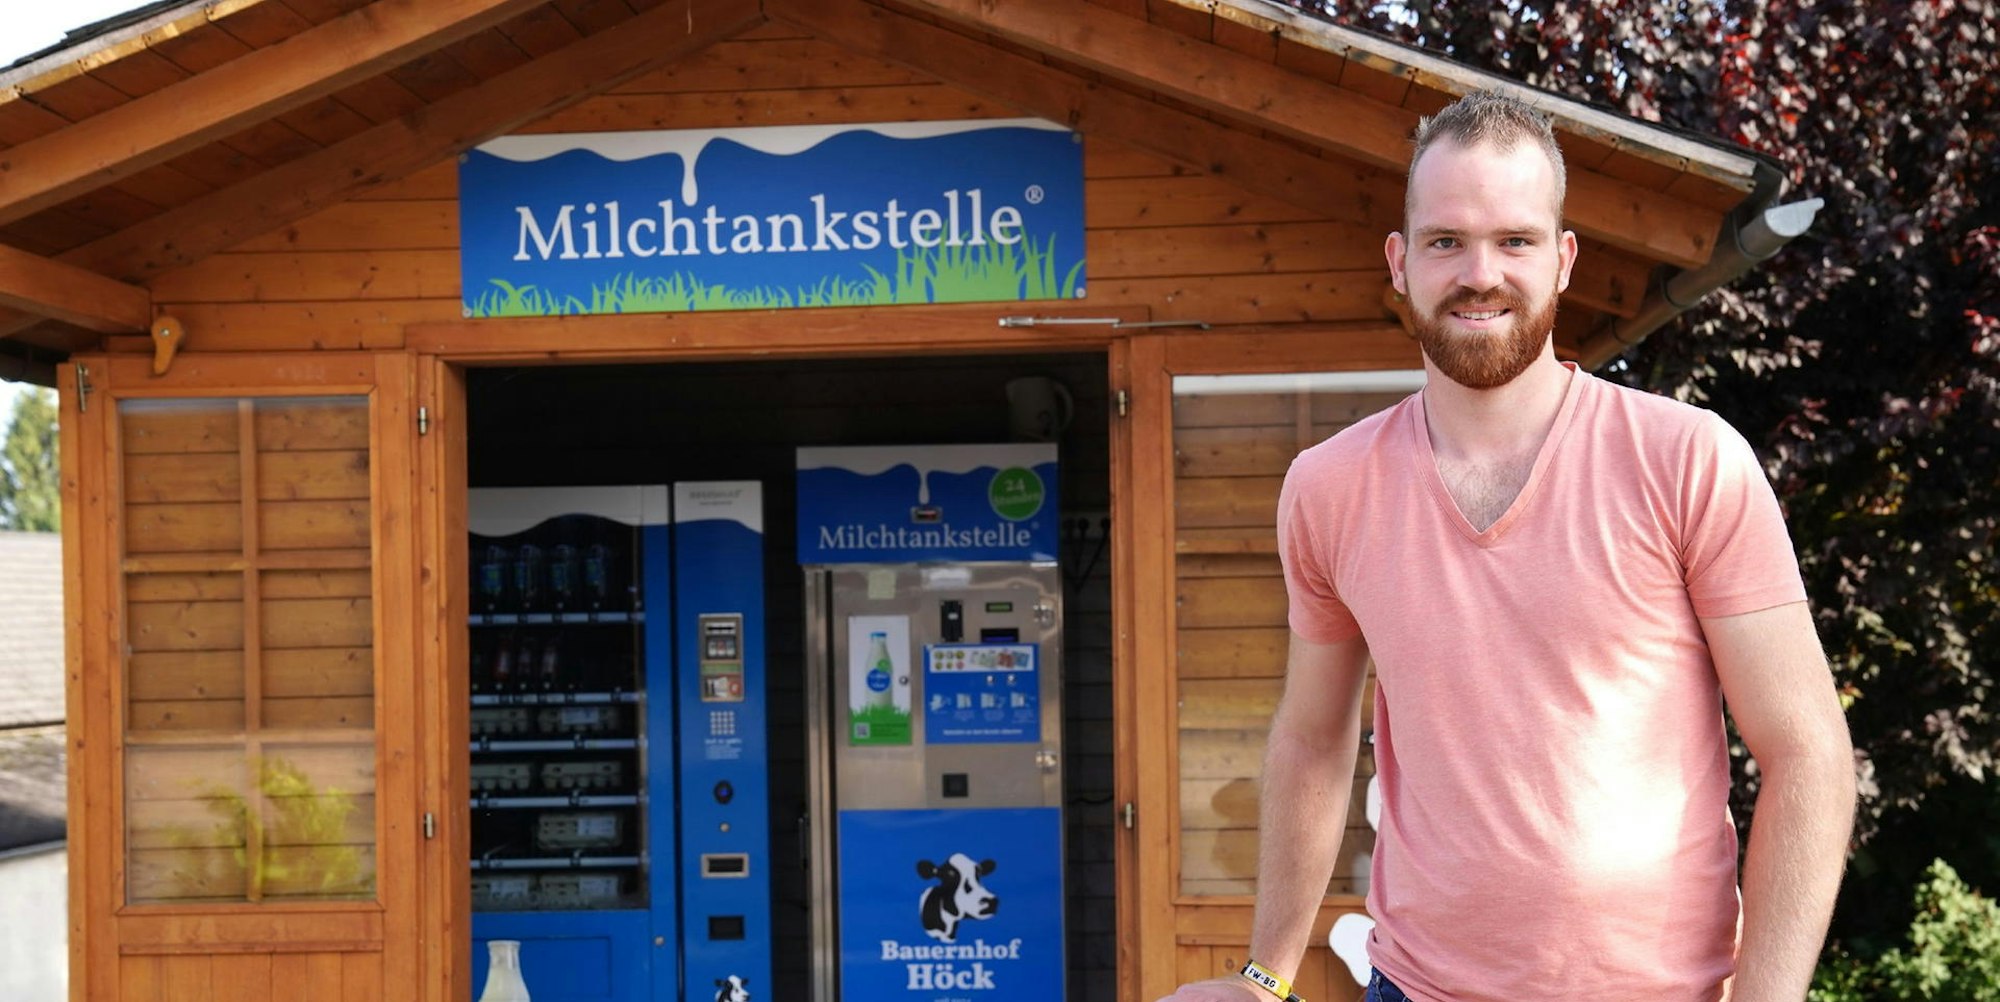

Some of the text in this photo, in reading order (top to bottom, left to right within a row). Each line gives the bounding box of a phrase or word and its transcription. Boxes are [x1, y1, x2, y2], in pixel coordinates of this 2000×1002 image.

[1003, 478, 1026, 492] 24
[881, 938, 1022, 961] Bauernhof
[907, 963, 996, 991] Höck
[1248, 968, 1276, 987] FW-BG
